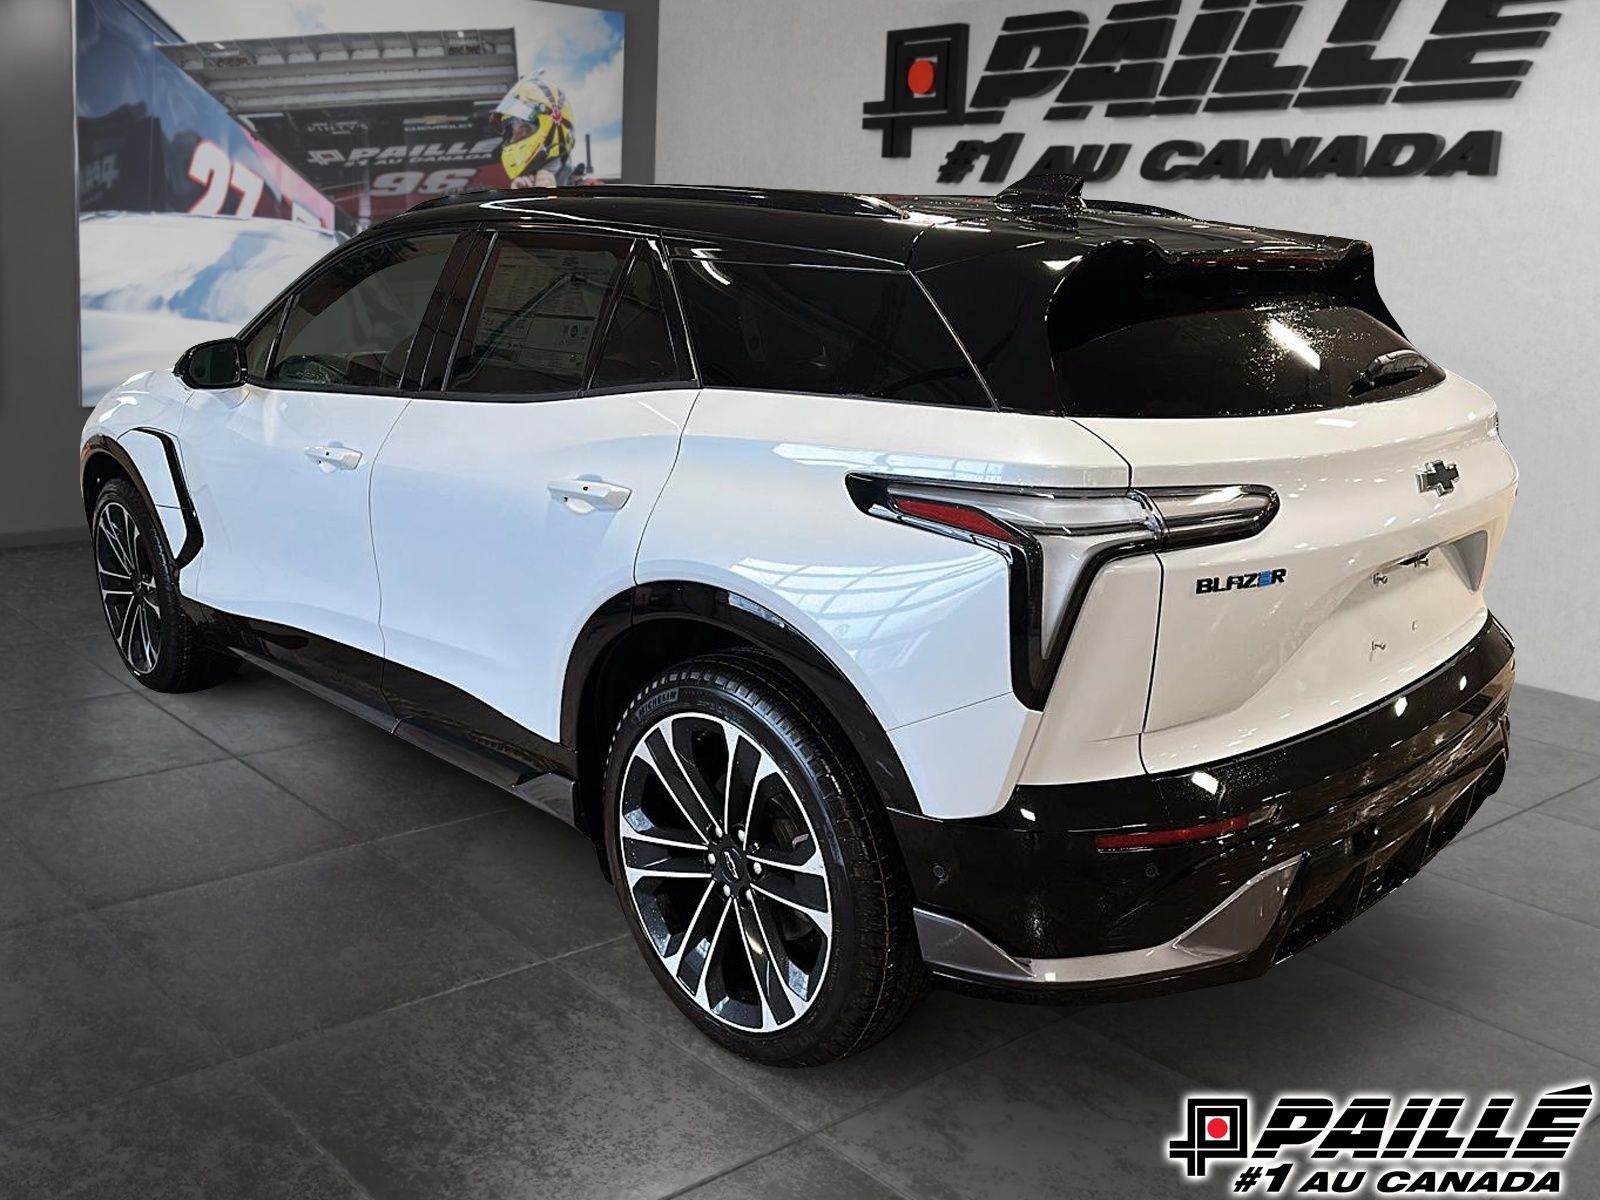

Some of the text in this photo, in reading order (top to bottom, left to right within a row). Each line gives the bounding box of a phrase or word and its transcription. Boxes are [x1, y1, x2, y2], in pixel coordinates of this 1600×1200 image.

[936, 132, 1026, 184] #1
[1139, 130, 1503, 180] CANADA
[370, 168, 477, 196] 96
[1196, 568, 1287, 594] BLAZER
[637, 690, 678, 717] MICHELIN
